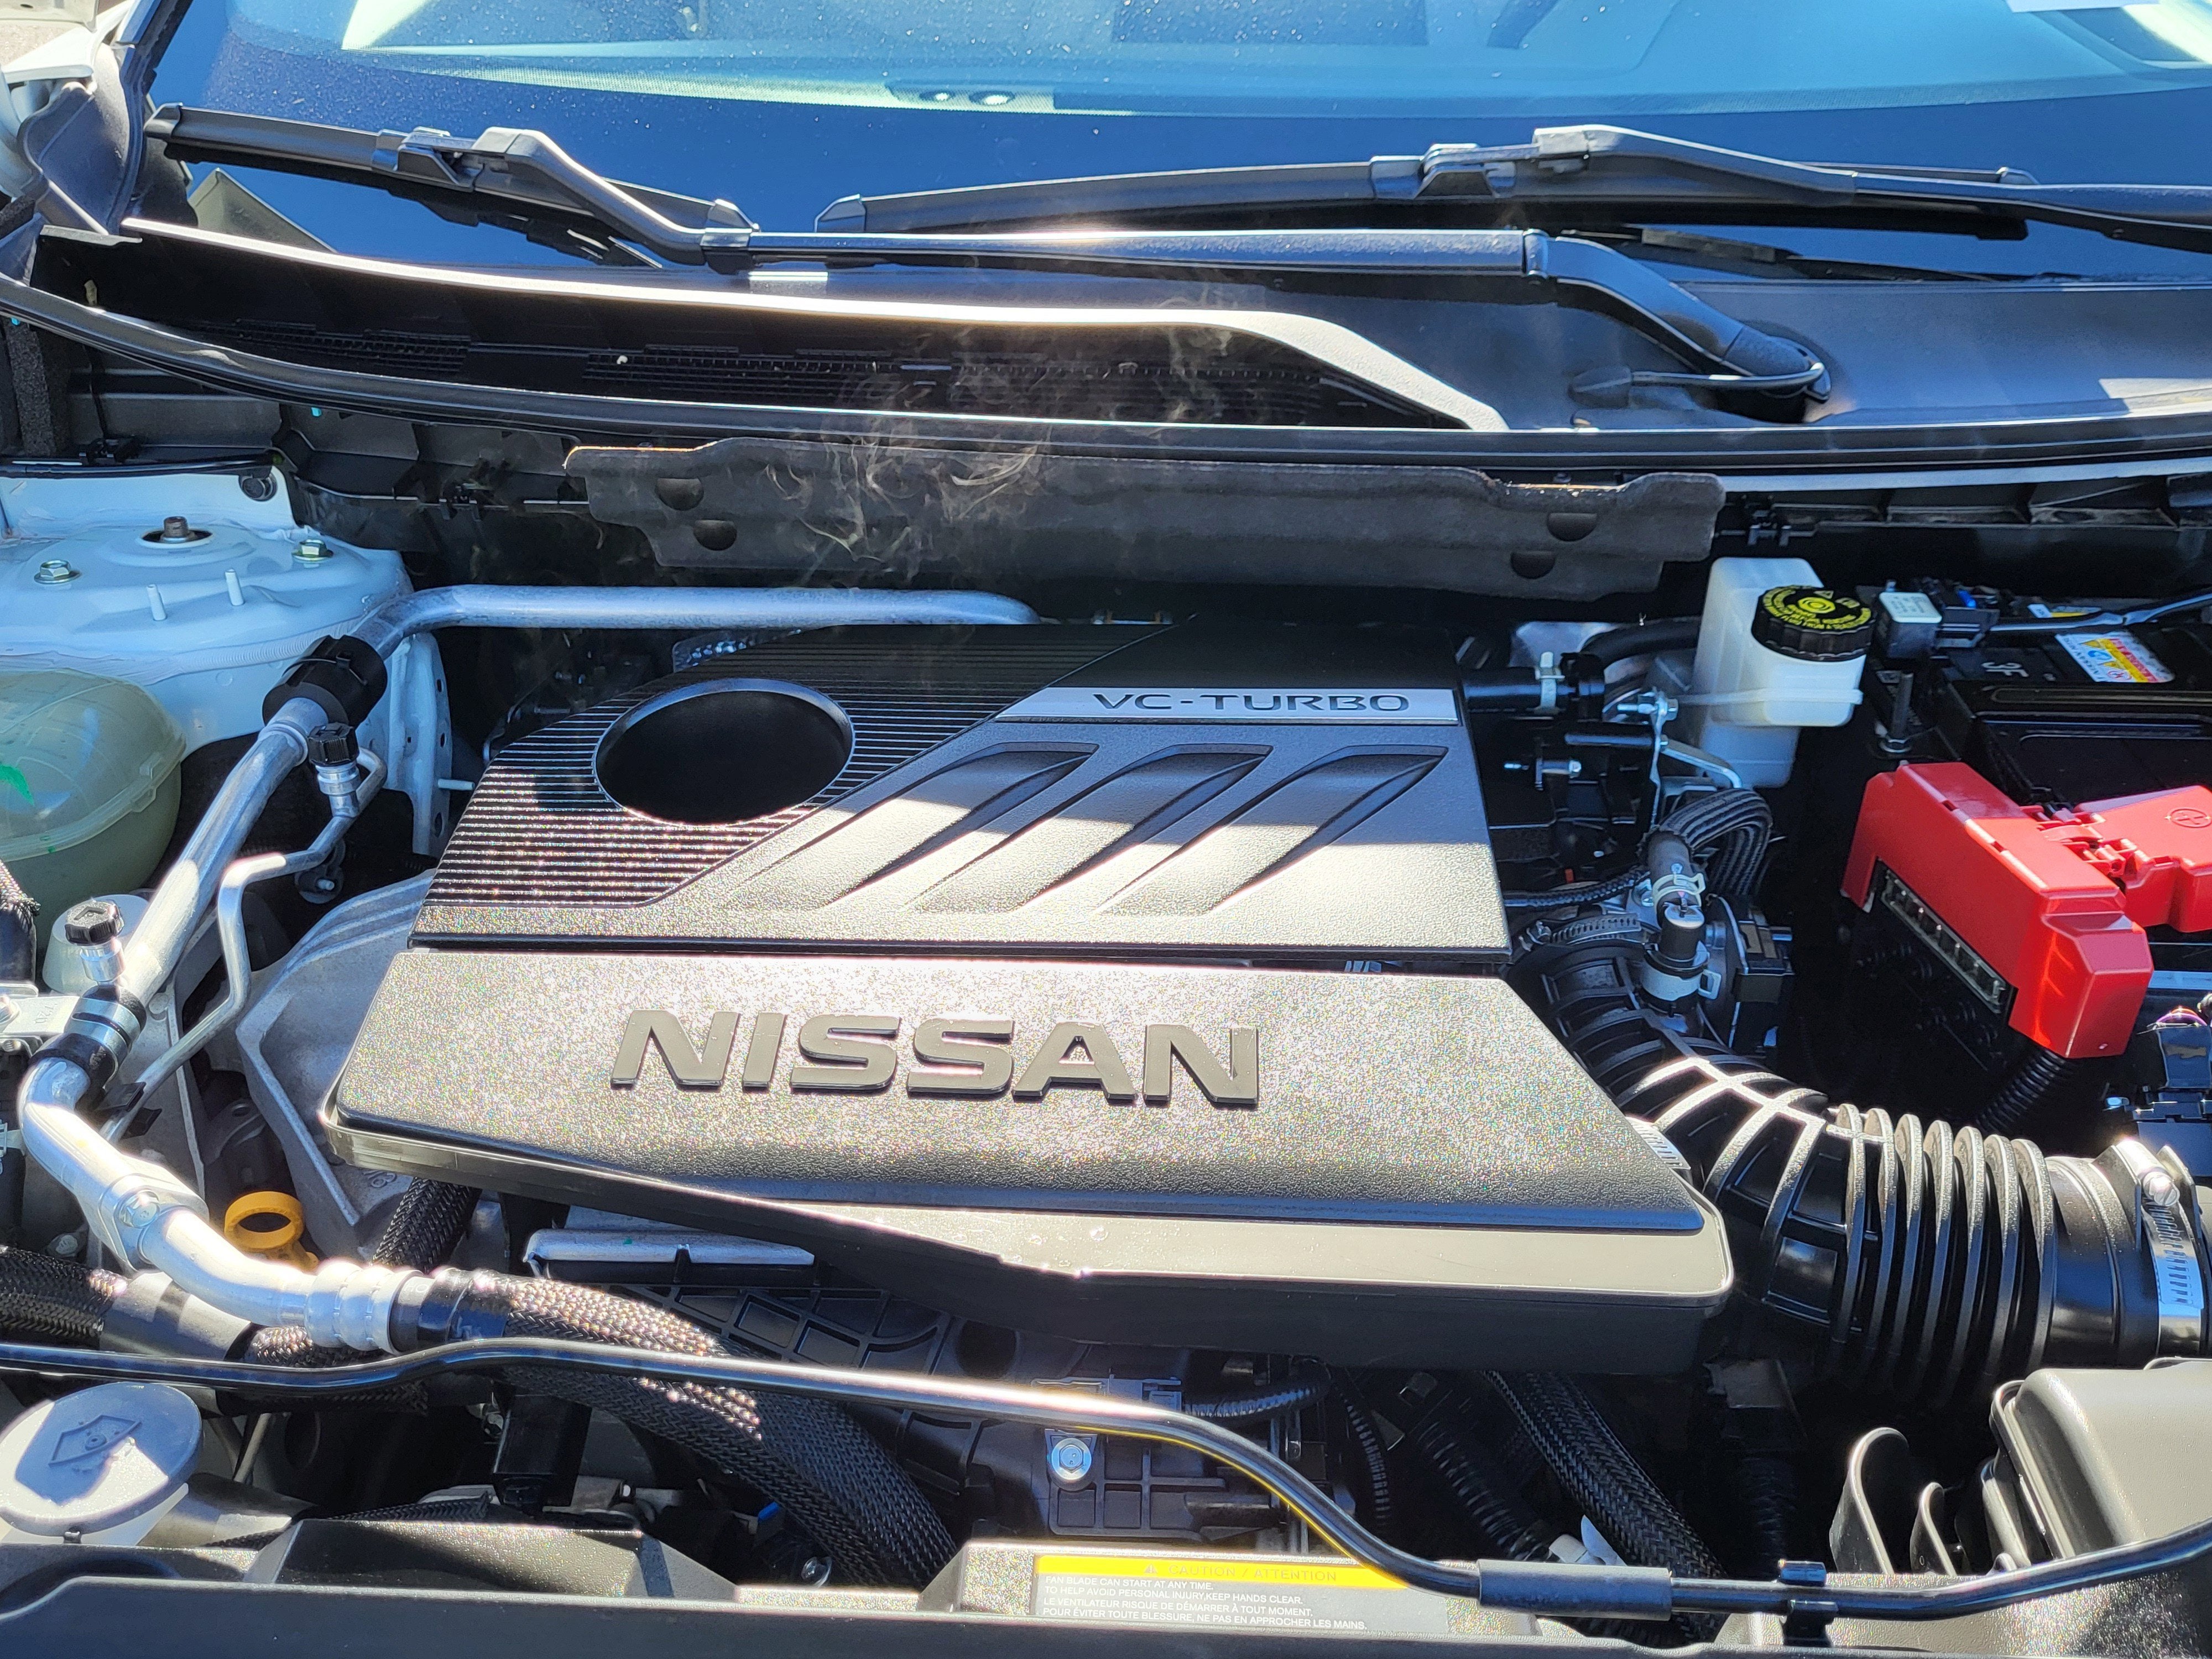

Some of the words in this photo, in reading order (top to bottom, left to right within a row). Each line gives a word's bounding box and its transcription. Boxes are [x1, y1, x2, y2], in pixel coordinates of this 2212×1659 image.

[1093, 693, 1410, 712] VC-TURBO
[611, 1009, 1260, 1105] NISSAN
[1168, 1563, 1235, 1577] CAUTION
[1254, 1568, 1337, 1582] ATTENTION
[1045, 1577, 1064, 1585] FAN
[1066, 1577, 1098, 1586] BLADE
[1099, 1578, 1120, 1587] CAN
[1122, 1579, 1152, 1588] START
[1154, 1580, 1166, 1589] AT
[1167, 1581, 1188, 1589] ANY
[1190, 1582, 1214, 1590] TIME.
[1045, 1586, 1058, 1595] TO
[1060, 1587, 1085, 1596] HELP
[1086, 1588, 1116, 1597] AVOID
[1118, 1589, 1171, 1599] PERSONAL
[1233, 1593, 1267, 1603] HANDS
[1269, 1595, 1303, 1604] CLEAR.
[1044, 1597, 1056, 1606] LE
[1057, 1598, 1122, 1609] VENTILATEUR
[1121, 1600, 1160, 1611] RISQUE
[1161, 1602, 1175, 1611] DE
[1176, 1601, 1230, 1614] DÉMARRER
[1231, 1603, 1239, 1614] À
[1240, 1605, 1267, 1615] TOUT
[1043, 1608, 1071, 1618] POUR
[1073, 1606, 1106, 1619] ÉVITER
[1108, 1610, 1140, 1620] TOUTE
[1141, 1611, 1195, 1624] BLESSURE,
[1196, 1614, 1211, 1623] NE
[1212, 1614, 1232, 1624] PAS
[1234, 1615, 1248, 1625] EN
[1249, 1616, 1312, 1627] APPROCHER
[1313, 1618, 1332, 1628] LES
[1333, 1619, 1368, 1630] MAINS.
